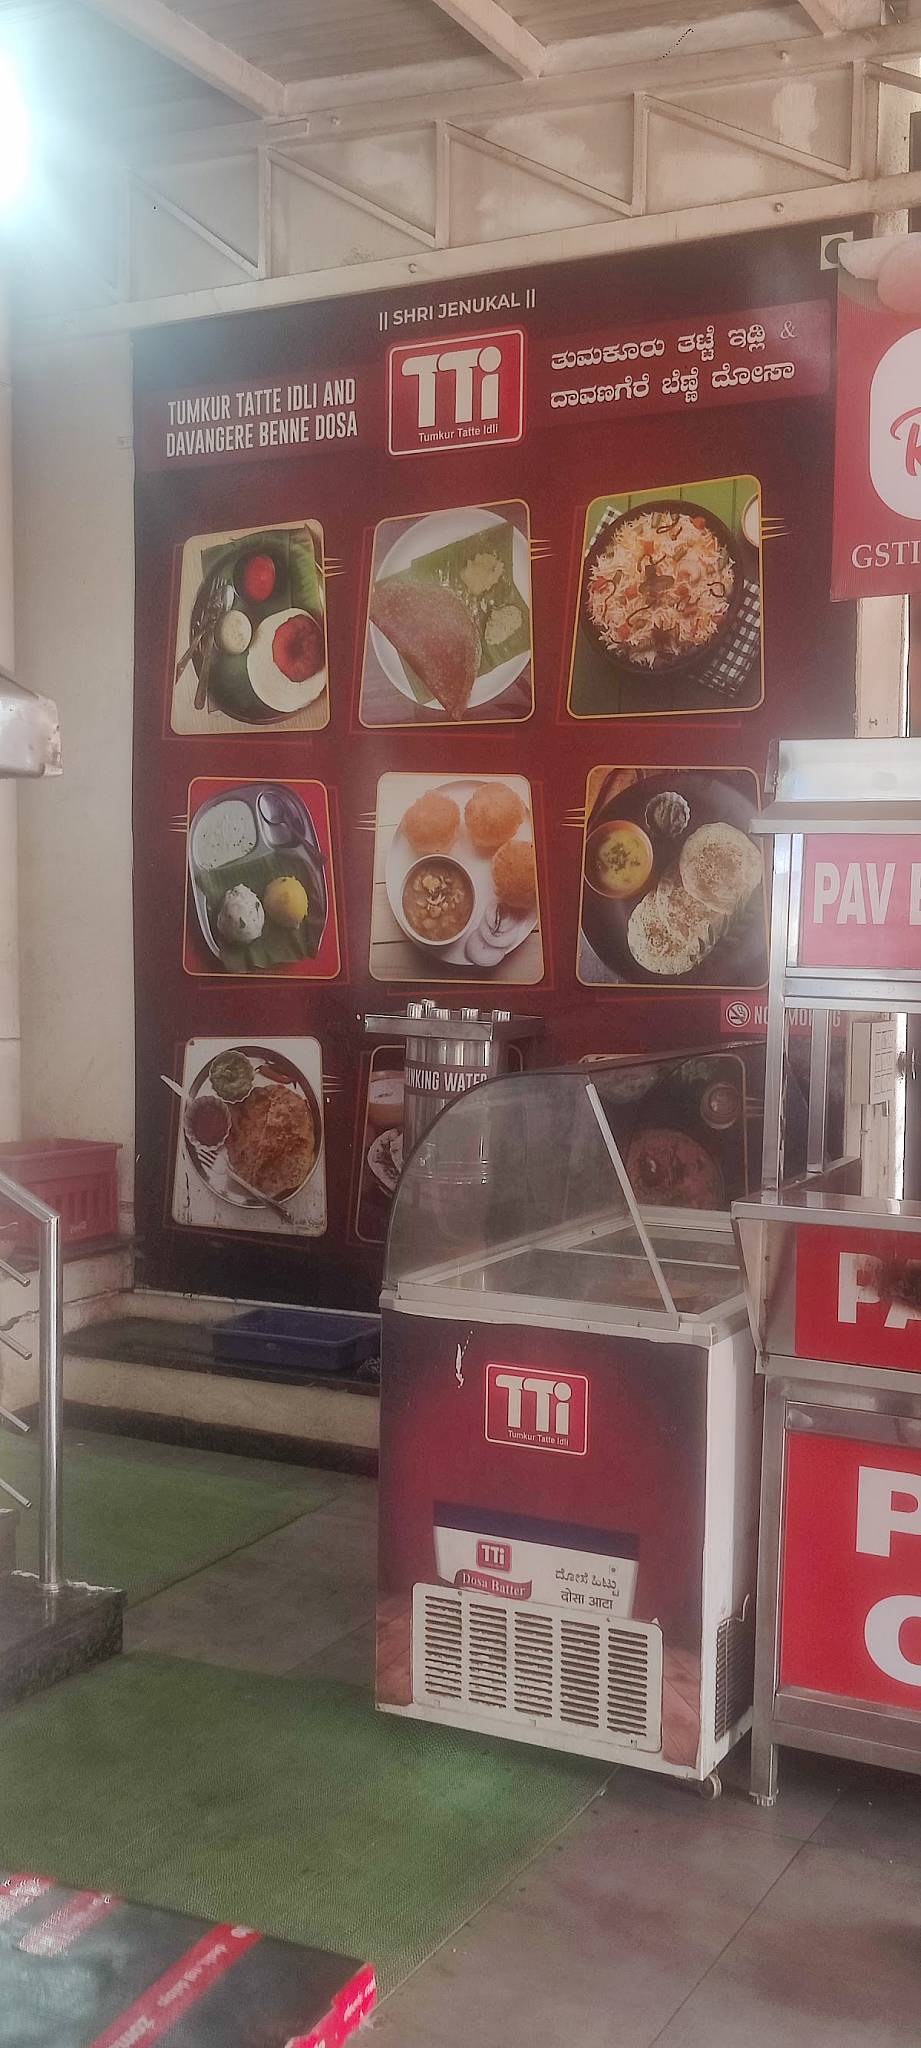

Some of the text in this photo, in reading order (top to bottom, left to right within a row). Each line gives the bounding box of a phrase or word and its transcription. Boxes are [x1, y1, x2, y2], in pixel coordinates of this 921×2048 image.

[393, 305, 433, 325] SHRI
[438, 292, 521, 319] JENUKAL
[551, 320, 797, 370] ತುಮಕೂರು ತಟ್ಟೆ ಇಡ್ಲಿ &
[167, 378, 356, 426] TUMKUR TATTE IDLI AND
[550, 362, 795, 409] ದಾವಣಗೆರೆ ಬೆಣ್ಣೆ ದೋಸಾ
[166, 410, 358, 458] DAVANGERE BENNE DOSA
[419, 423, 498, 443] Tumkur Tatte Idli
[813, 862, 896, 925] PAV
[406, 1067, 440, 1091] INKING
[508, 1429, 569, 1446] Tumkur Tatte Idli
[463, 1573, 526, 1597] Dosa Batter
[588, 1596, 614, 1610] आटा
